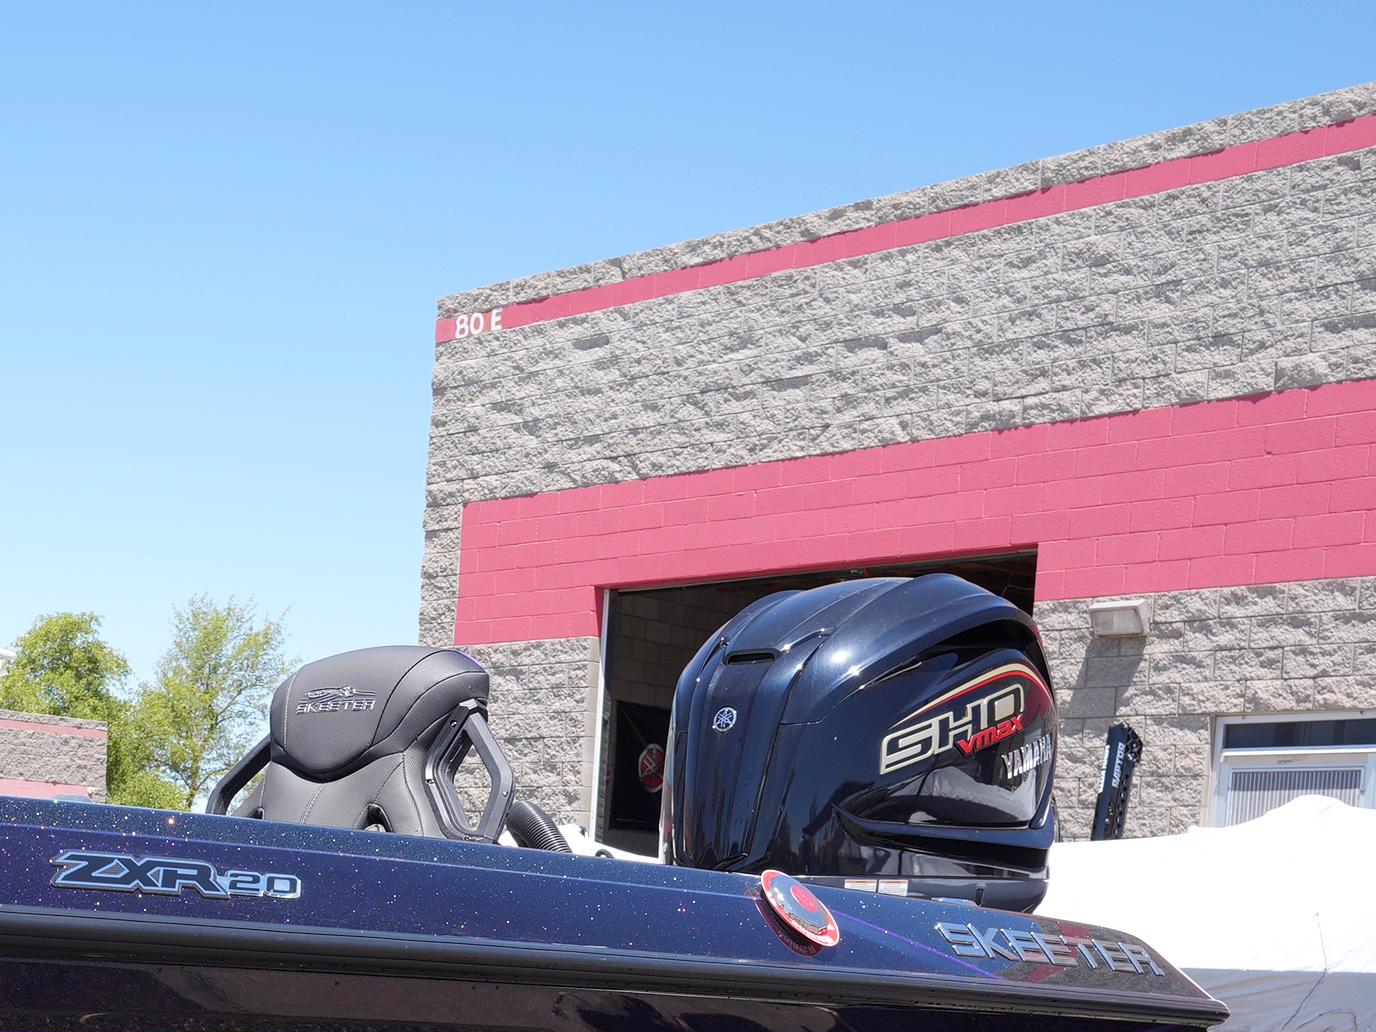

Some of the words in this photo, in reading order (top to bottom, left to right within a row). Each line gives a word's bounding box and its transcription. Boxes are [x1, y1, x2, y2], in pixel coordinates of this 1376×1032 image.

[490, 307, 504, 331] E
[296, 699, 376, 715] SKEETER
[880, 683, 1024, 776] SHO
[1001, 734, 1052, 780] YAMAHA
[1112, 741, 1126, 789] RAPTOR
[50, 849, 230, 899] ZXR
[225, 870, 302, 899] 20
[934, 921, 1165, 977] SKEETER
